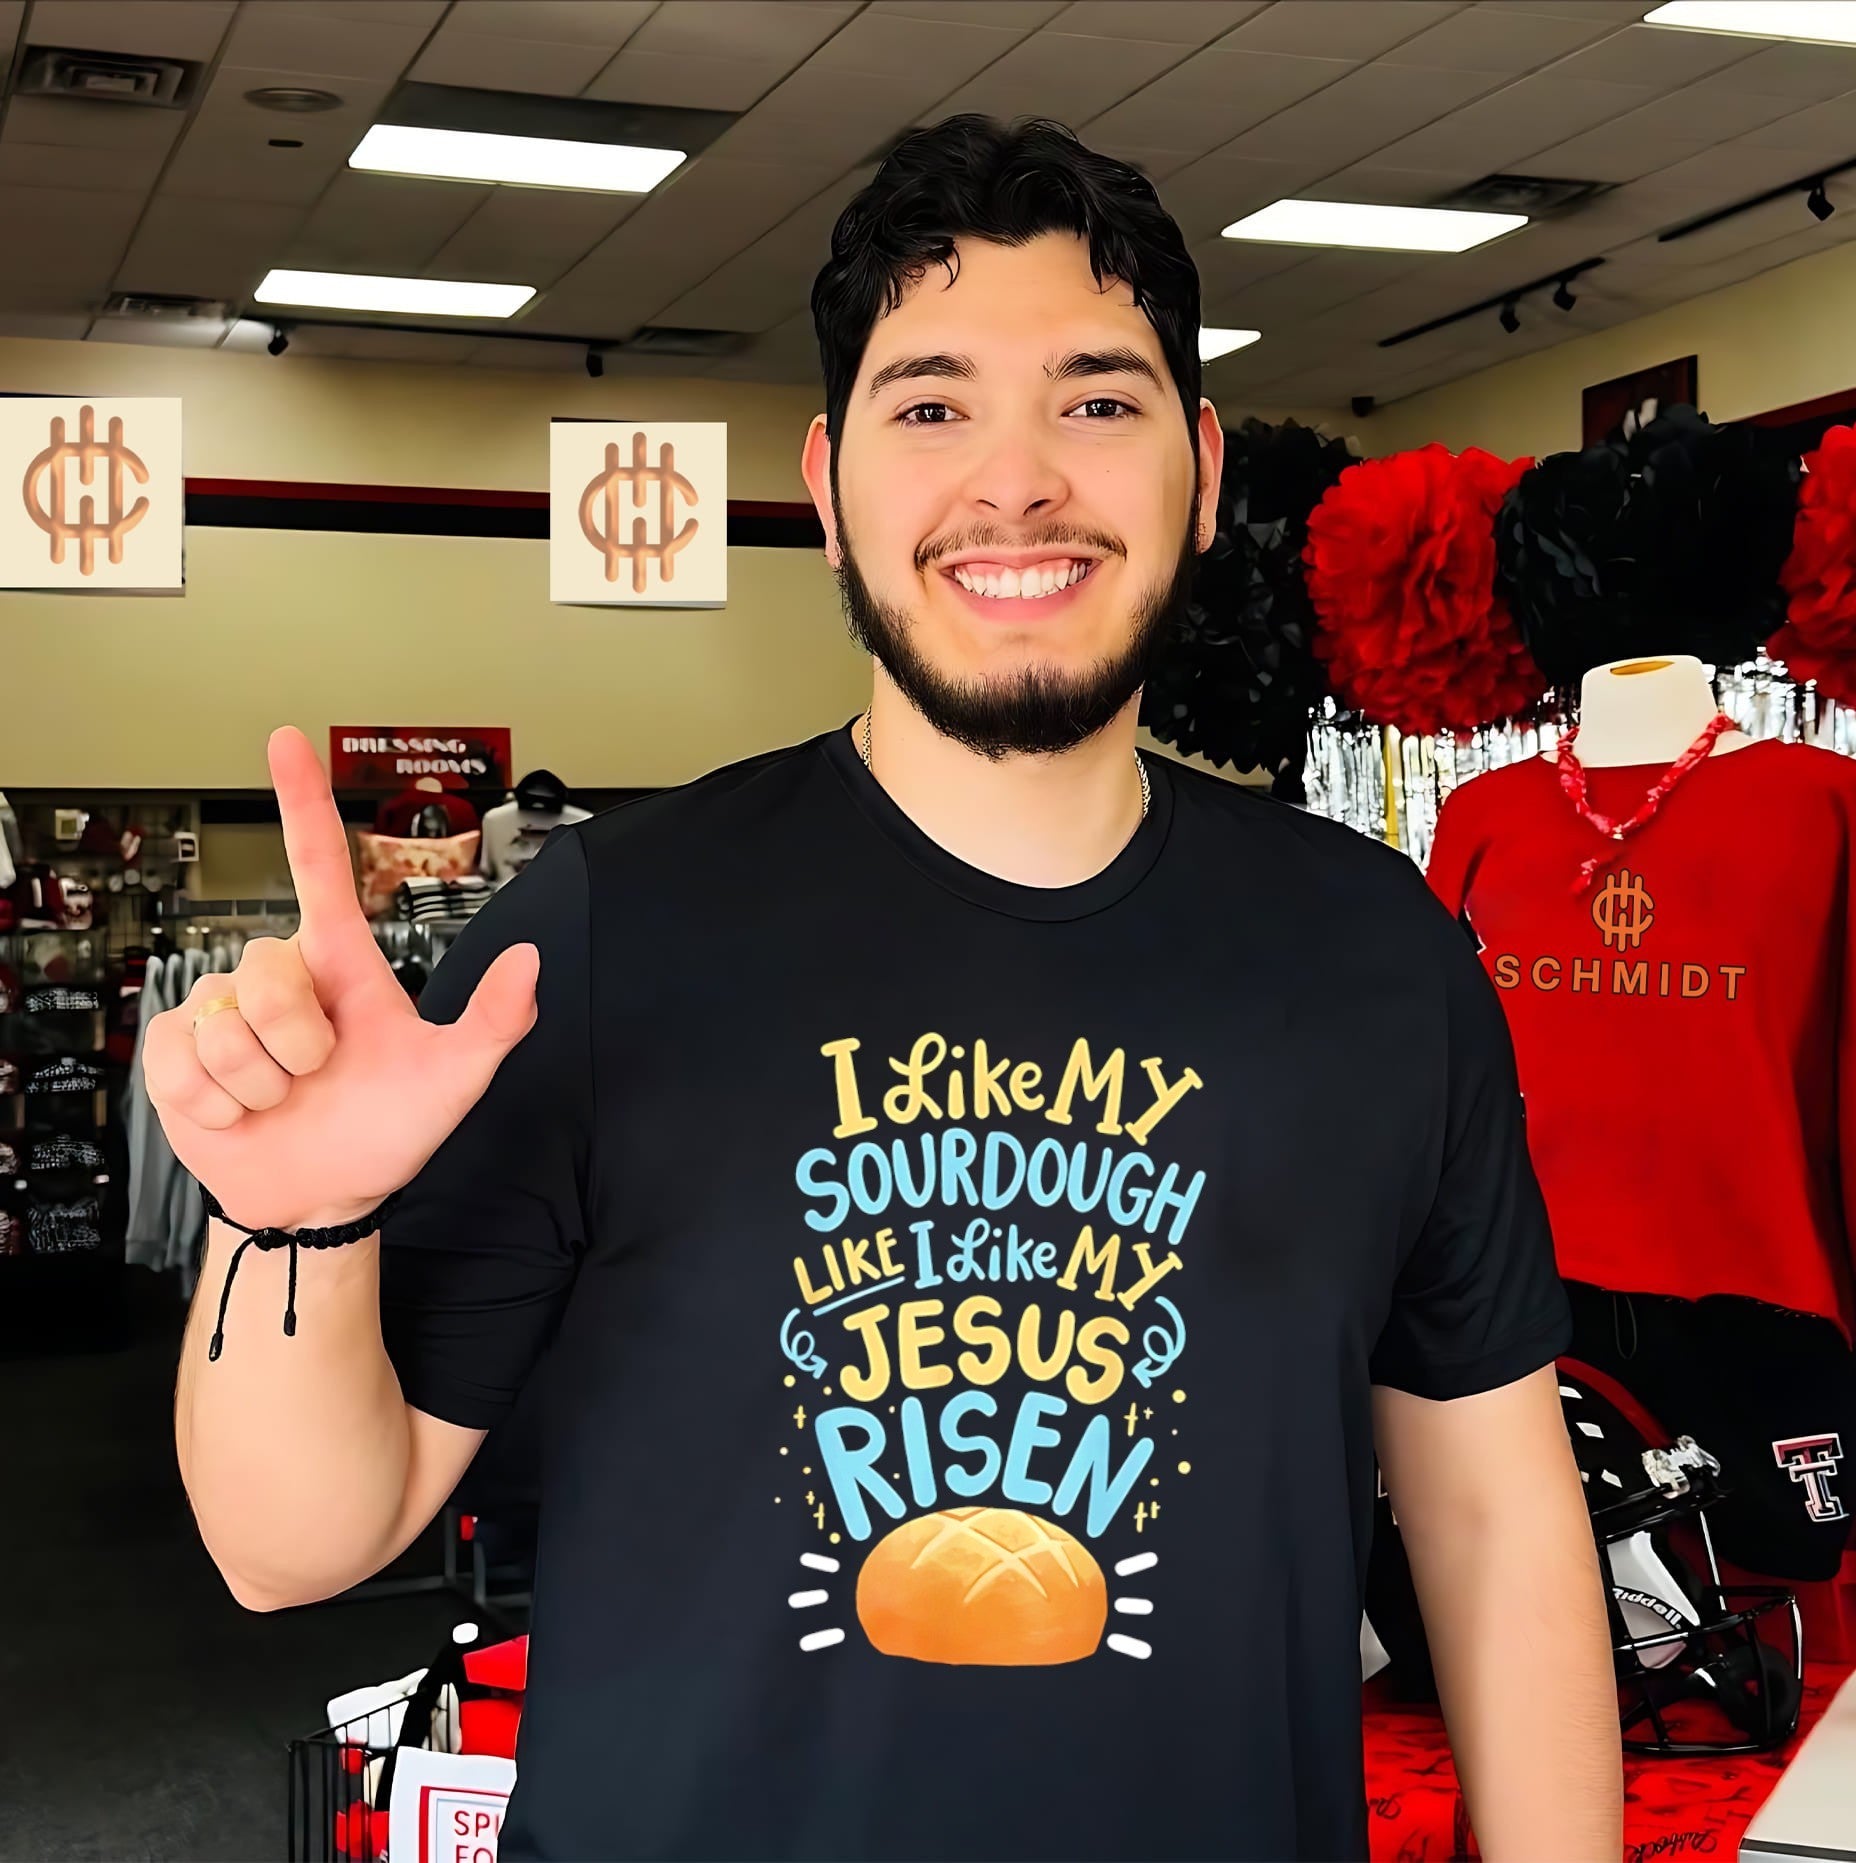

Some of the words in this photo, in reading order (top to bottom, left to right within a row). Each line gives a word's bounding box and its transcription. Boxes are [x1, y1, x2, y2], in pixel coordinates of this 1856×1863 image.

[341, 737, 467, 754] DRESSING
[395, 757, 487, 776] ROOMS
[1494, 953, 1747, 1000] SCHMIDT
[820, 1037, 879, 1140] I
[882, 1031, 1046, 1125] Like
[795, 1127, 1207, 1246] SOURDOUGH
[793, 1226, 906, 1305] LIKE
[908, 1219, 944, 1290] I
[946, 1217, 1058, 1283] Like
[839, 1294, 1131, 1405] JESUS
[814, 1389, 1156, 1542] RISEN
